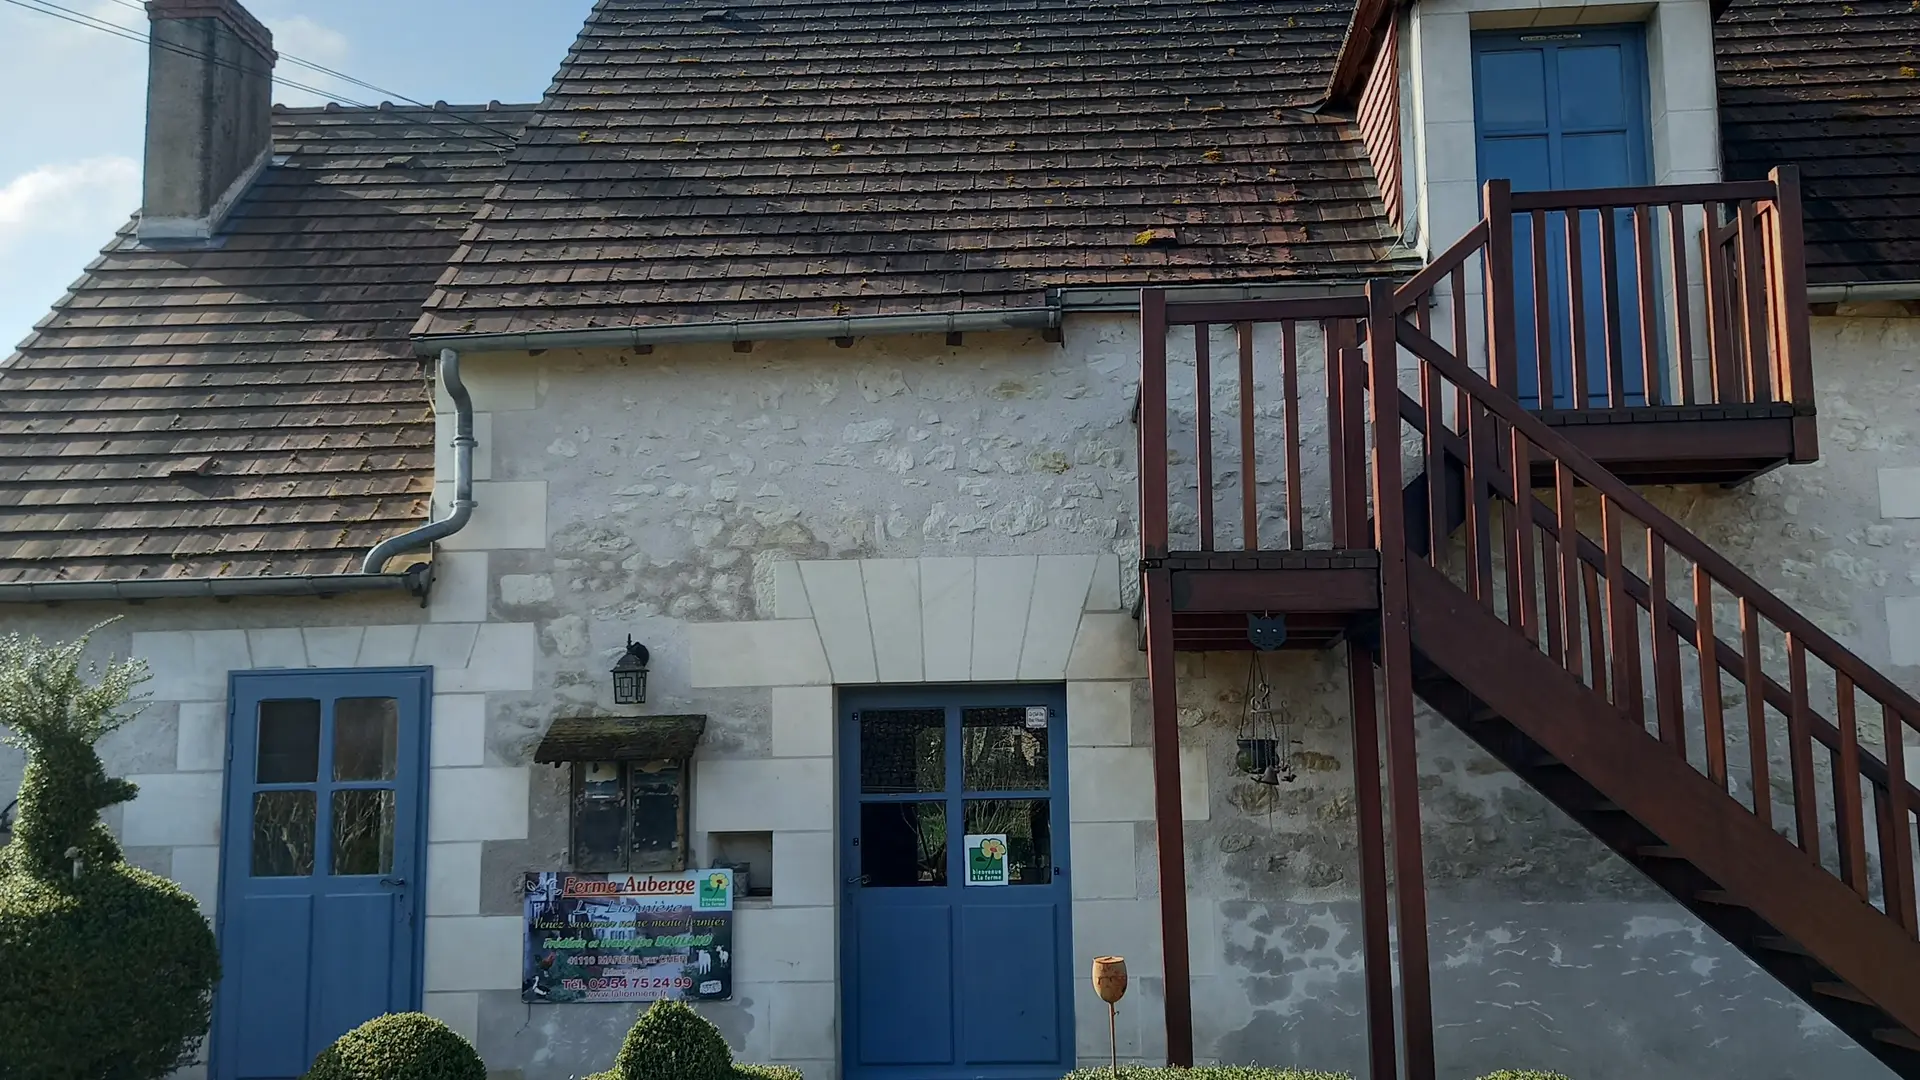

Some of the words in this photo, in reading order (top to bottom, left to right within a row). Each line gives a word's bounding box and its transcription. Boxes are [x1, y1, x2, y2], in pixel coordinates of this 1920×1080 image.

[564, 876, 617, 894] Ferme
[623, 876, 695, 894] Auberge
[573, 900, 596, 914] La
[605, 901, 682, 913] Lionnière
[534, 917, 564, 928] Venez
[685, 915, 726, 930] fermier
[562, 979, 586, 989] Tél.
[588, 977, 608, 990] 02
[610, 977, 628, 989] 54
[632, 977, 649, 988] 75
[652, 977, 671, 988] 24
[673, 976, 693, 989] 99
